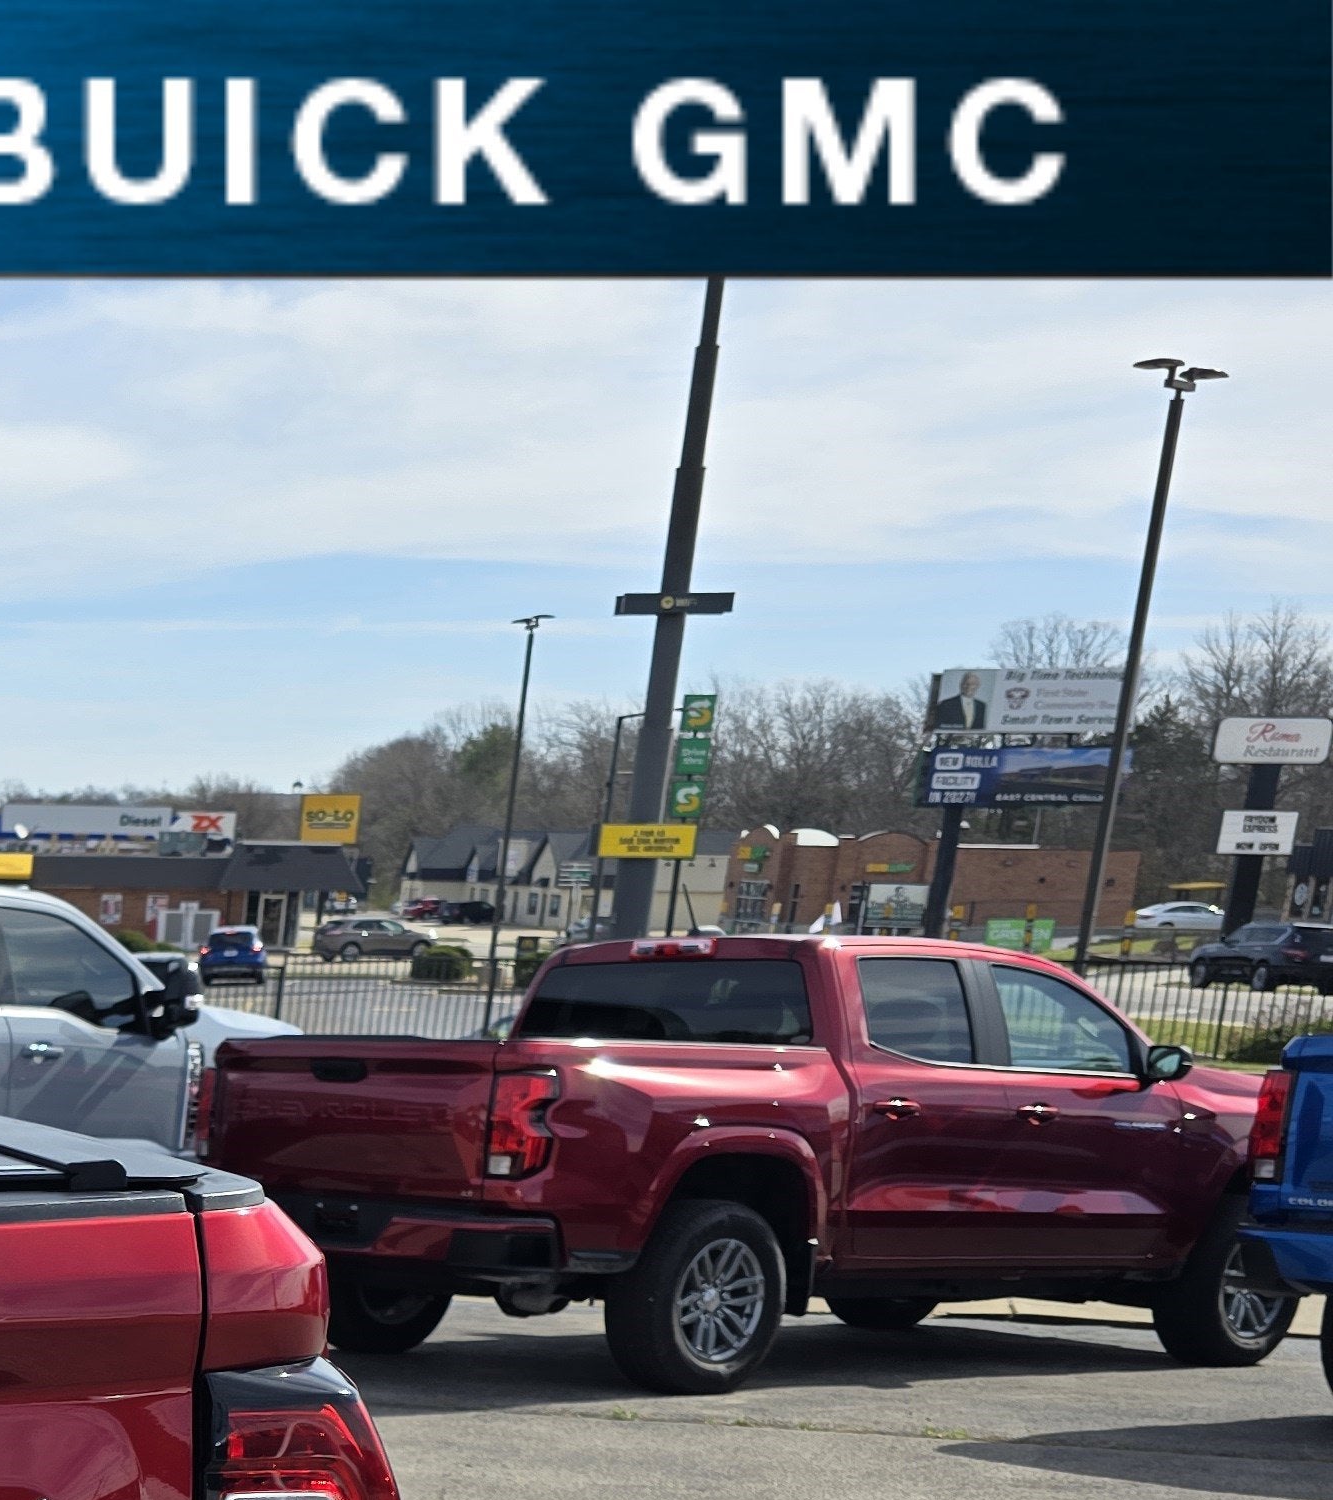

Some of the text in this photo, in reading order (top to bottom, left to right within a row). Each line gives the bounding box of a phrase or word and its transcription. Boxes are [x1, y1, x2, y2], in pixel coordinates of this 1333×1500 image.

[1243, 744, 1319, 758] Restaurant
[119, 814, 163, 827] Diesel
[306, 809, 354, 822] SO-LO
